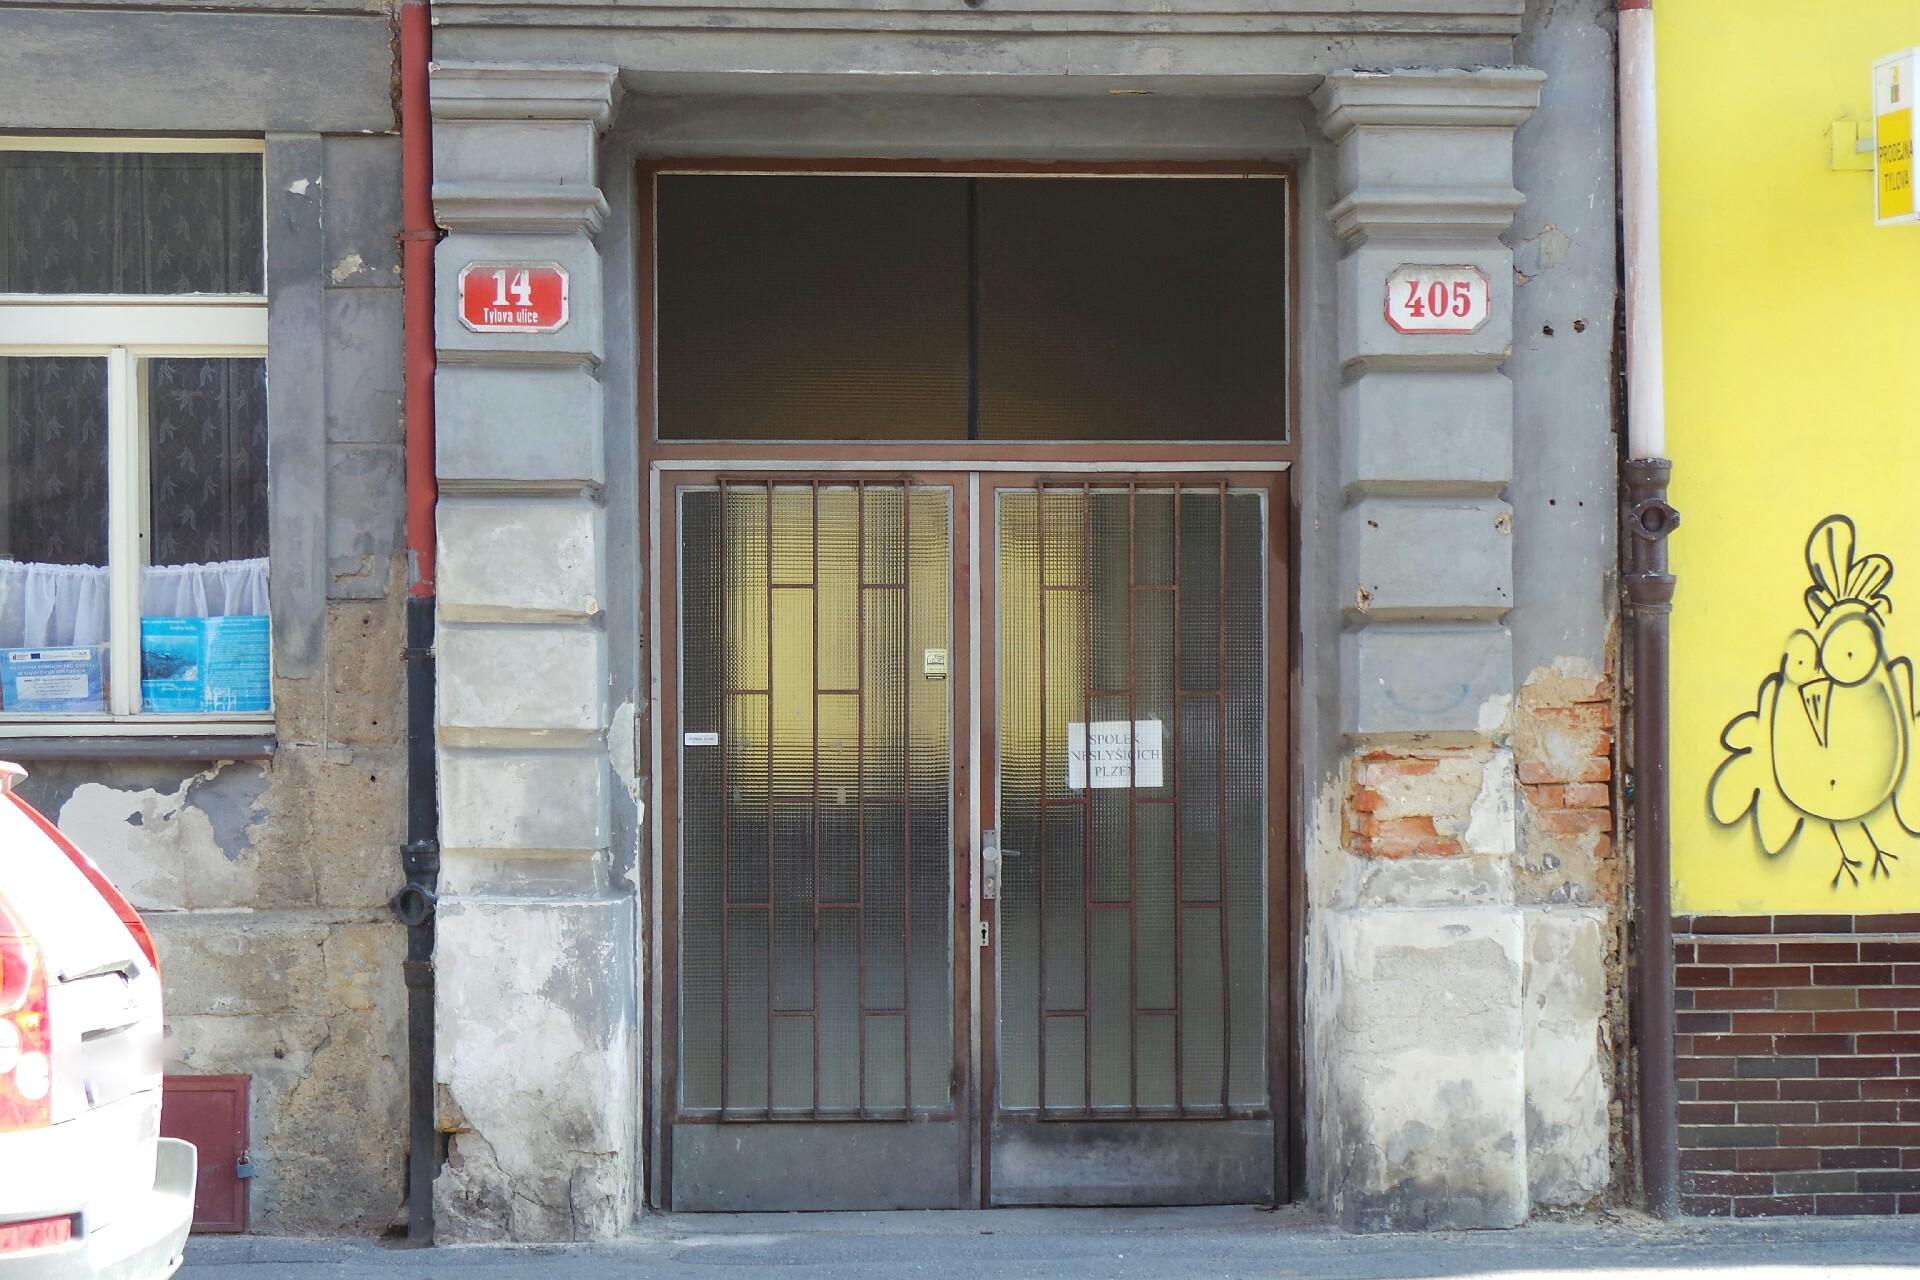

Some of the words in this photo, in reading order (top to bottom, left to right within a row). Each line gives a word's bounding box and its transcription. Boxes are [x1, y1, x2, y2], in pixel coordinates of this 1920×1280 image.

[1879, 139, 1913, 163] PRODEJNA
[1884, 168, 1910, 192] TYLOVA
[492, 269, 533, 306] 14
[1404, 280, 1471, 318] 405
[483, 308, 513, 324] Tylova
[516, 310, 538, 323] ulice
[1093, 766, 1133, 777] PLZE
